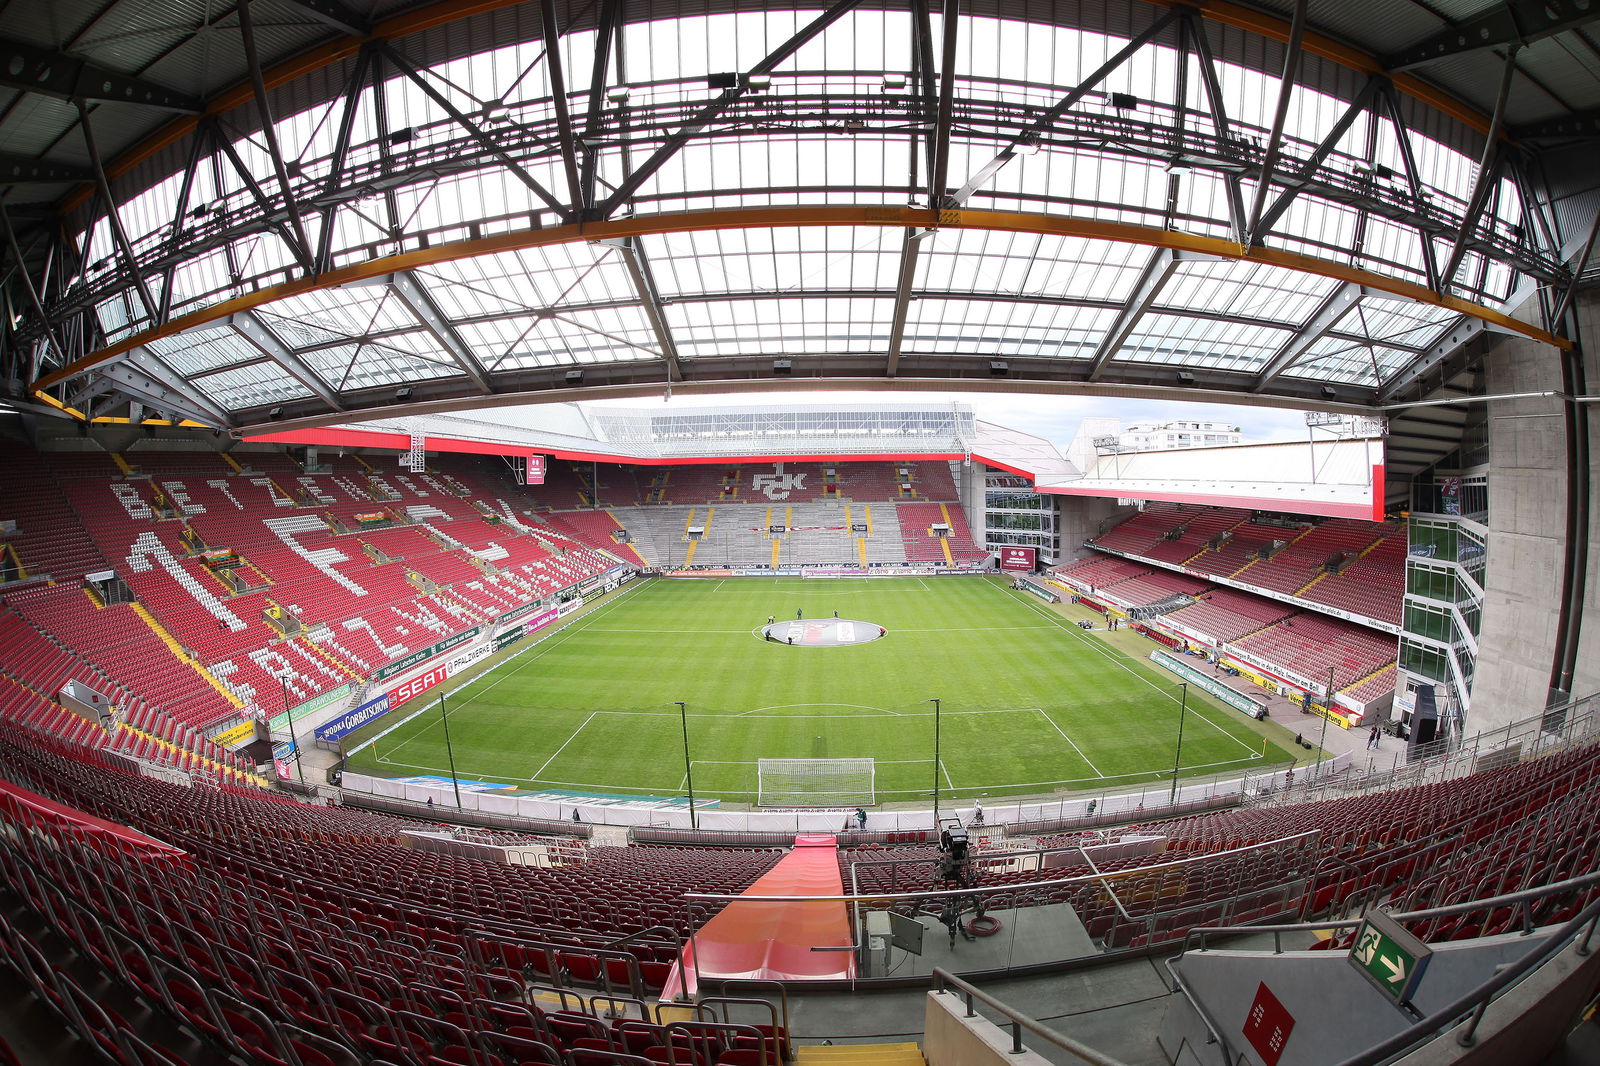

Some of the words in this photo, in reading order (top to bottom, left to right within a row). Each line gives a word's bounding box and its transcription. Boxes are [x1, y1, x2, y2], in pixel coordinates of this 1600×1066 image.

[109, 474, 472, 519] BETZENBERG
[453, 644, 490, 668] PFALZWERKE
[1225, 645, 1247, 661] Volkswagen
[1247, 654, 1261, 667] Partner
[1285, 670, 1301, 685] Immer
[1300, 679, 1309, 688] am
[398, 666, 446, 702] SEAT
[323, 722, 345, 738] WODKA
[345, 698, 390, 730] GORBATSCHOW
